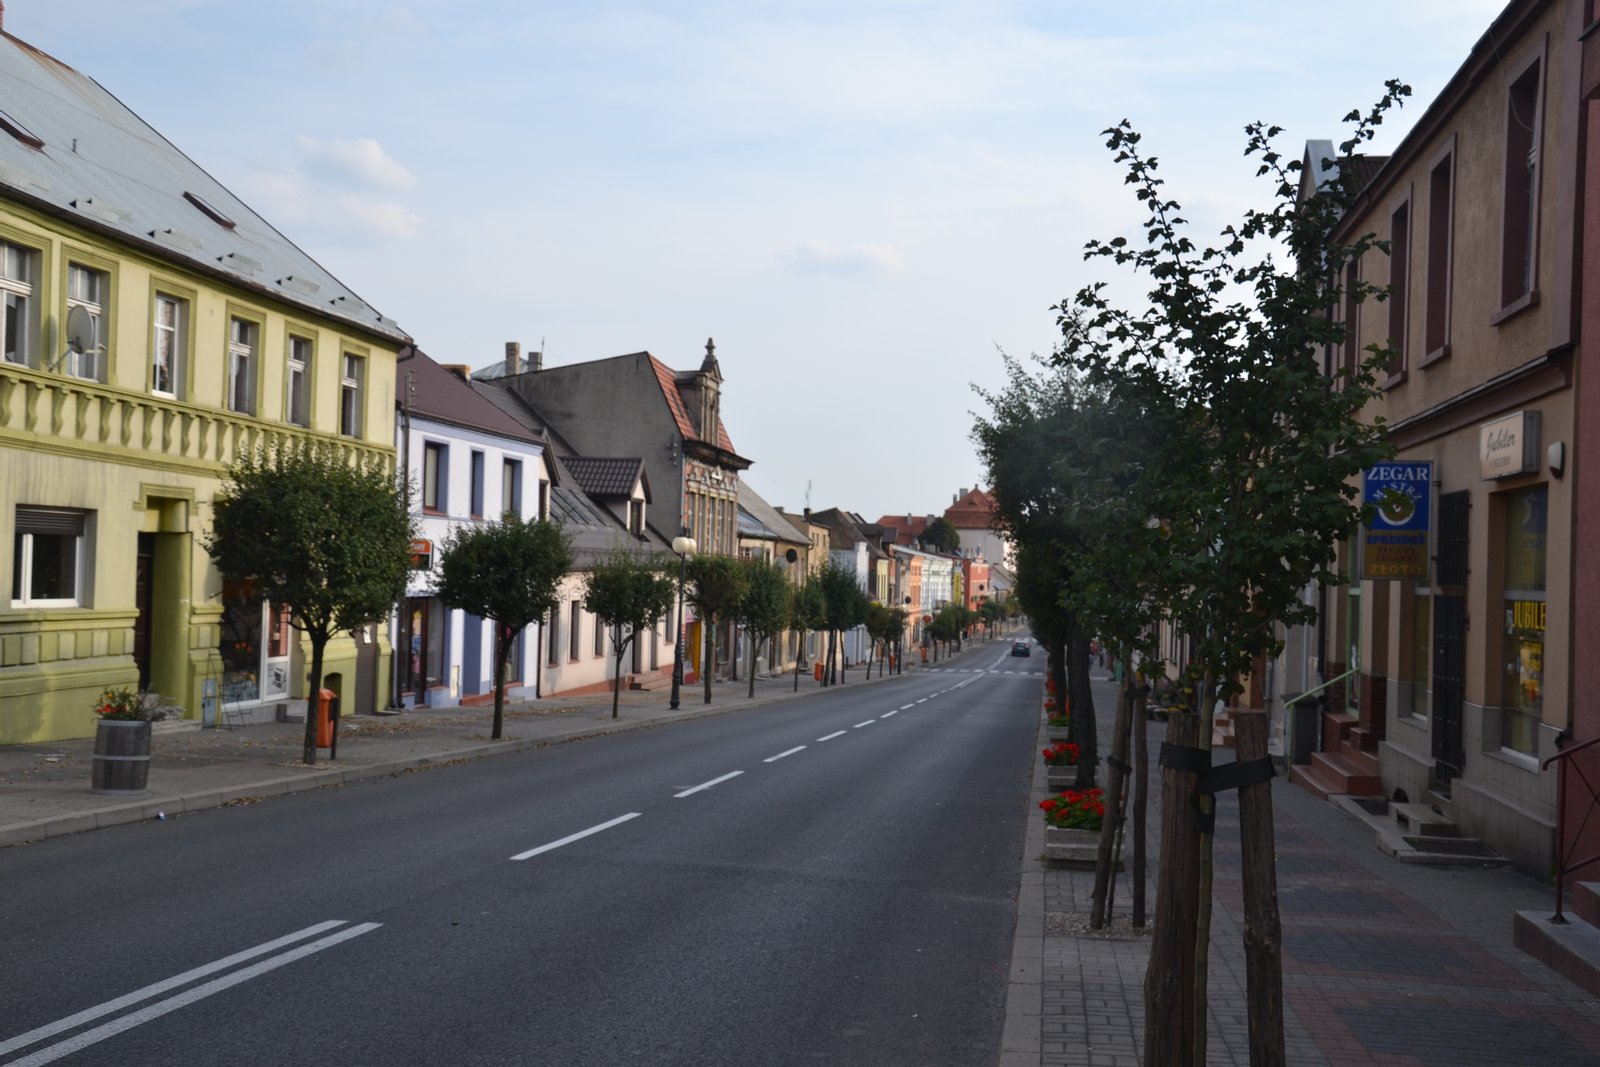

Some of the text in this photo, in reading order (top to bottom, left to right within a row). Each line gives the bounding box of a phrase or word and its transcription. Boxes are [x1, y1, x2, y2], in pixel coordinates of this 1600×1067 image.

[1367, 467, 1428, 481] ZEGAR
[1373, 482, 1422, 501] MSTRZ
[1369, 564, 1422, 575] ZŁOTO
